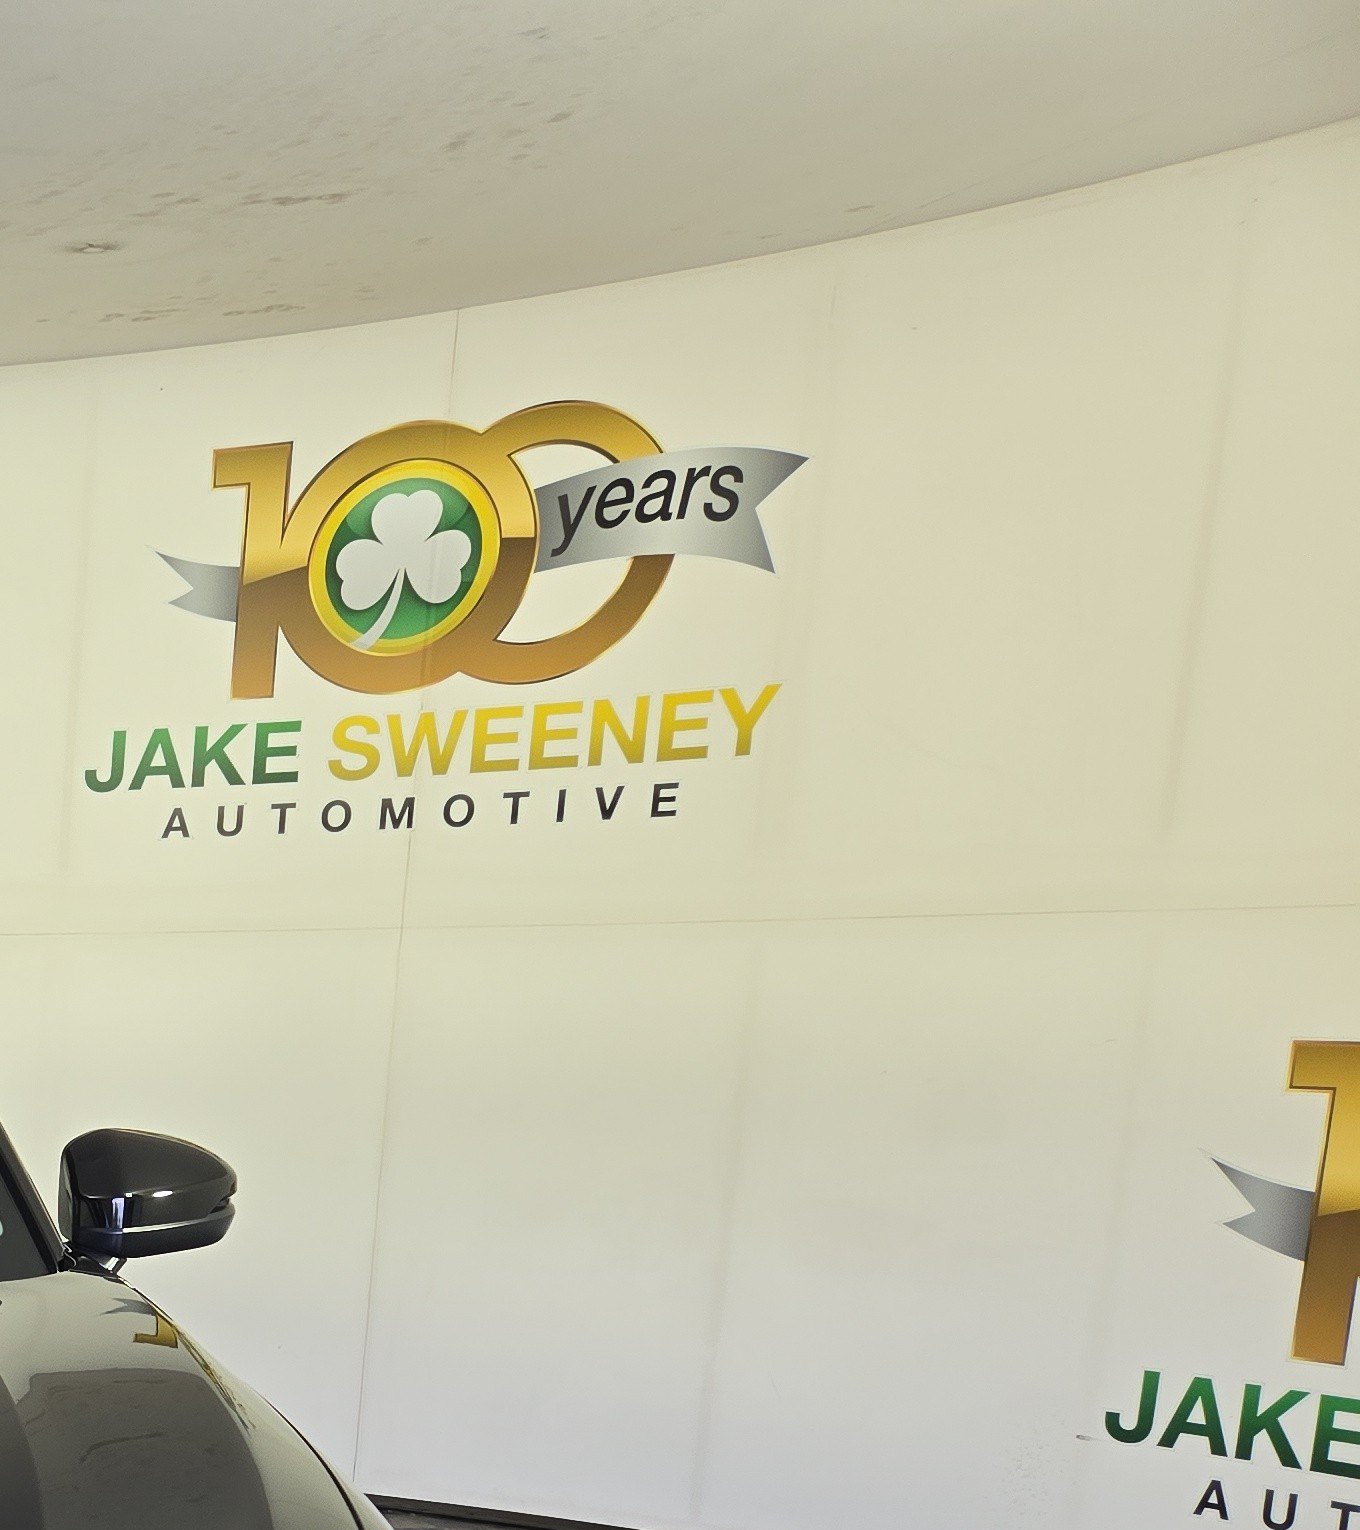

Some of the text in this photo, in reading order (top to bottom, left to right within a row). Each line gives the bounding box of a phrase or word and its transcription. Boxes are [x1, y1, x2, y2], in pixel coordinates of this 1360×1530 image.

[212, 399, 746, 700] 100 years
[83, 681, 784, 794] JAKE SWEENEY
[160, 780, 681, 841] AUTOMOTIVE
[1104, 1369, 1360, 1480] JAKE
